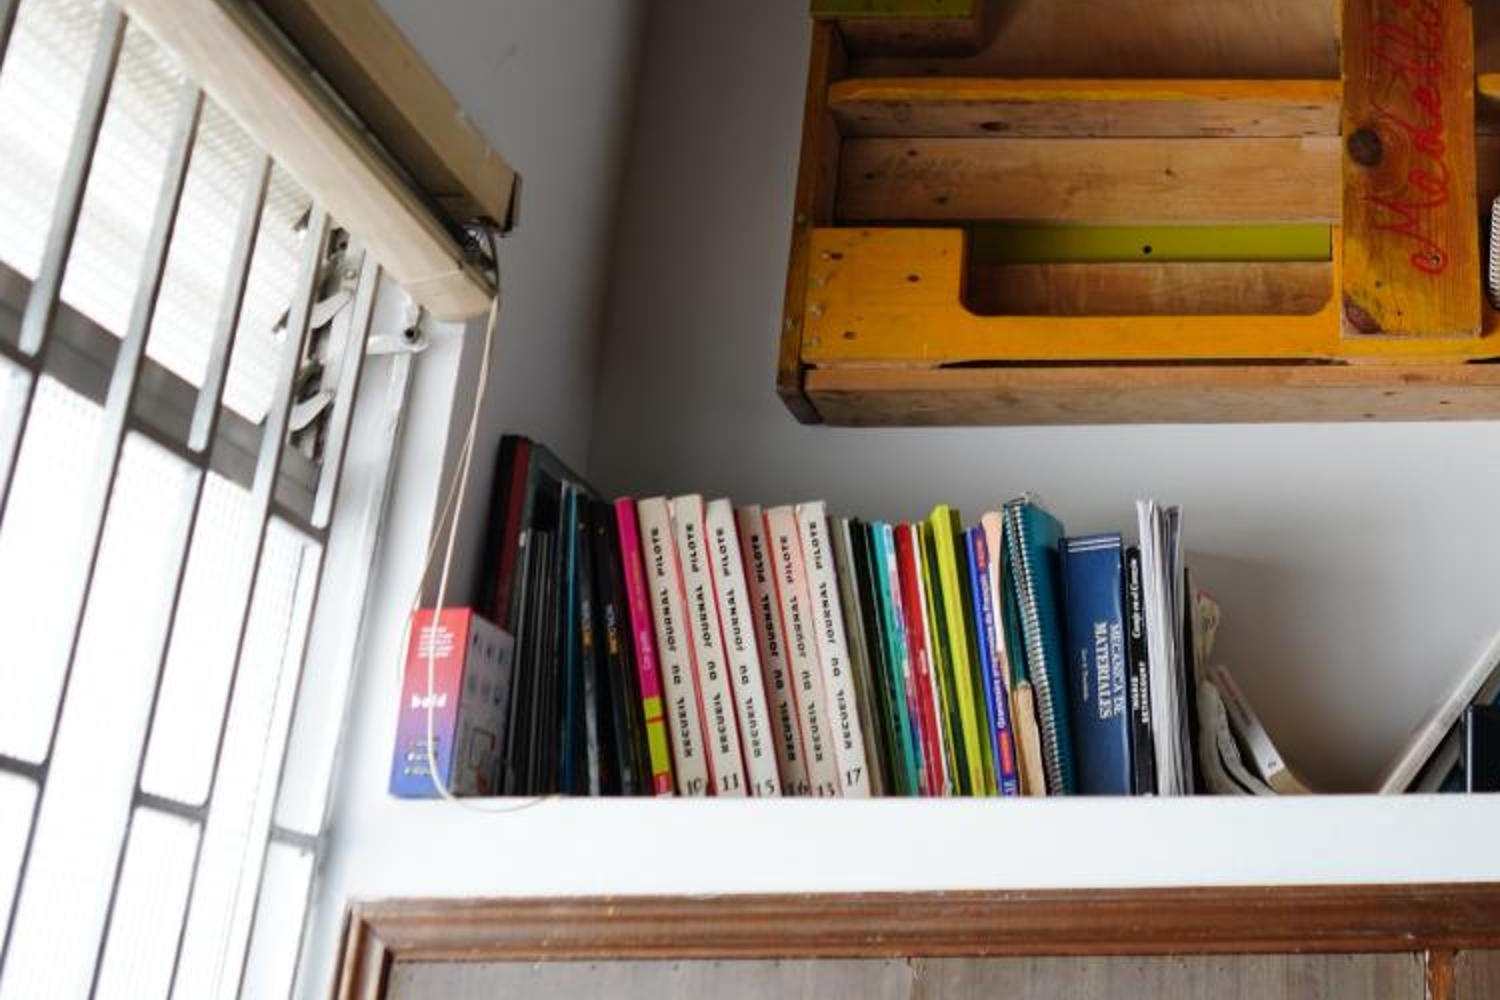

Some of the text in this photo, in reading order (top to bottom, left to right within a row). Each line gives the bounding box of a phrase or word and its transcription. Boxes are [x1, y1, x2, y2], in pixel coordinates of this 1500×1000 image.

[651, 528, 693, 757] RECUEIL DU JOURNAL PILOTE
[686, 523, 729, 754] RECUEIL DU JOURNAL PILOTE
[717, 528, 762, 758] RECUEIL DU JOURNAL PILOTE
[751, 535, 796, 762] RECUEIL DU JOURNAL PILOTE
[780, 535, 823, 762] RECUEIL DU JOURNAL PILOTE
[810, 521, 852, 750] RECUEIL DU JOURNAL PILOTE
[1094, 621, 1112, 720] MATERIALES
[722, 773, 739, 791] 11
[846, 767, 862, 787] 17
